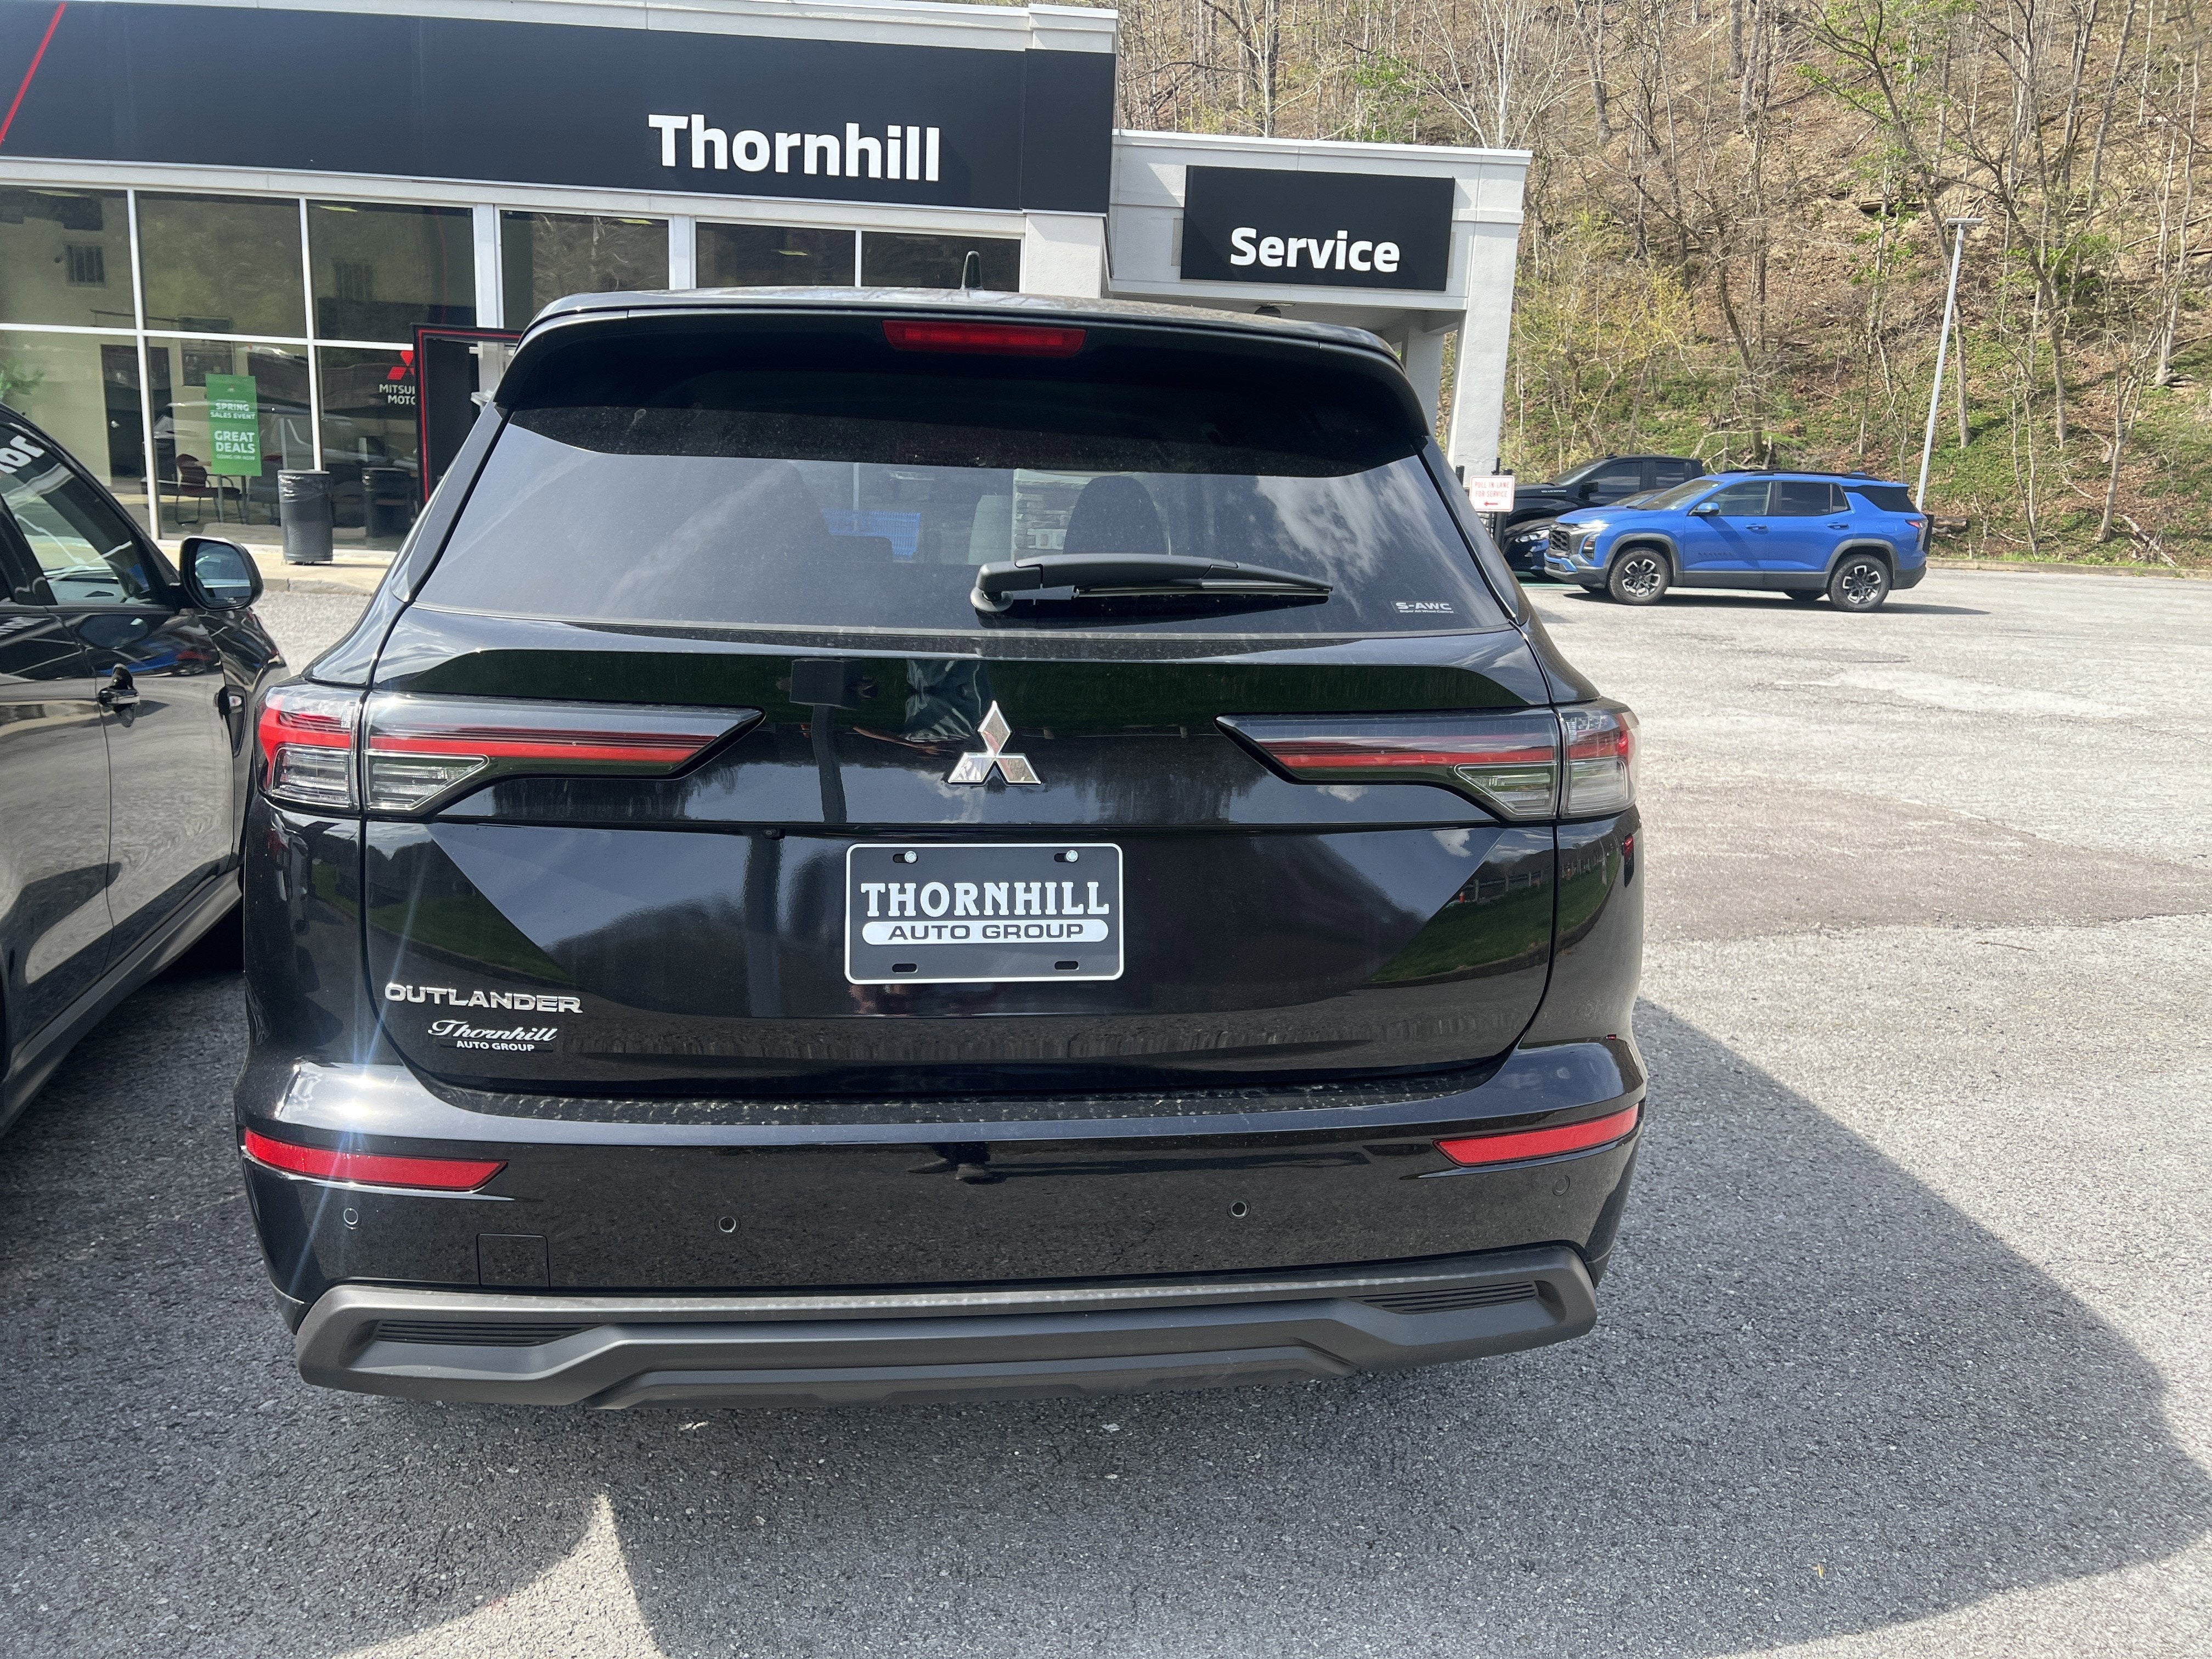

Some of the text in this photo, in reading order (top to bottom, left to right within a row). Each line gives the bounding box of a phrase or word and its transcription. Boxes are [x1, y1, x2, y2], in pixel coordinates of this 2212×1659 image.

[648, 113, 940, 182] Thornhill
[1230, 227, 1400, 273] Service
[216, 402, 250, 411] SPRING
[215, 430, 255, 442] GREAT
[216, 442, 255, 454] DEALS
[1395, 602, 1452, 610] S-AWC
[860, 881, 1109, 917] THORNHILL
[887, 923, 1085, 941] AUTO GROUP
[384, 983, 584, 1014] OUTLANDER
[427, 1019, 558, 1042] Thornhill
[456, 1040, 535, 1052] AUTO GROUP
